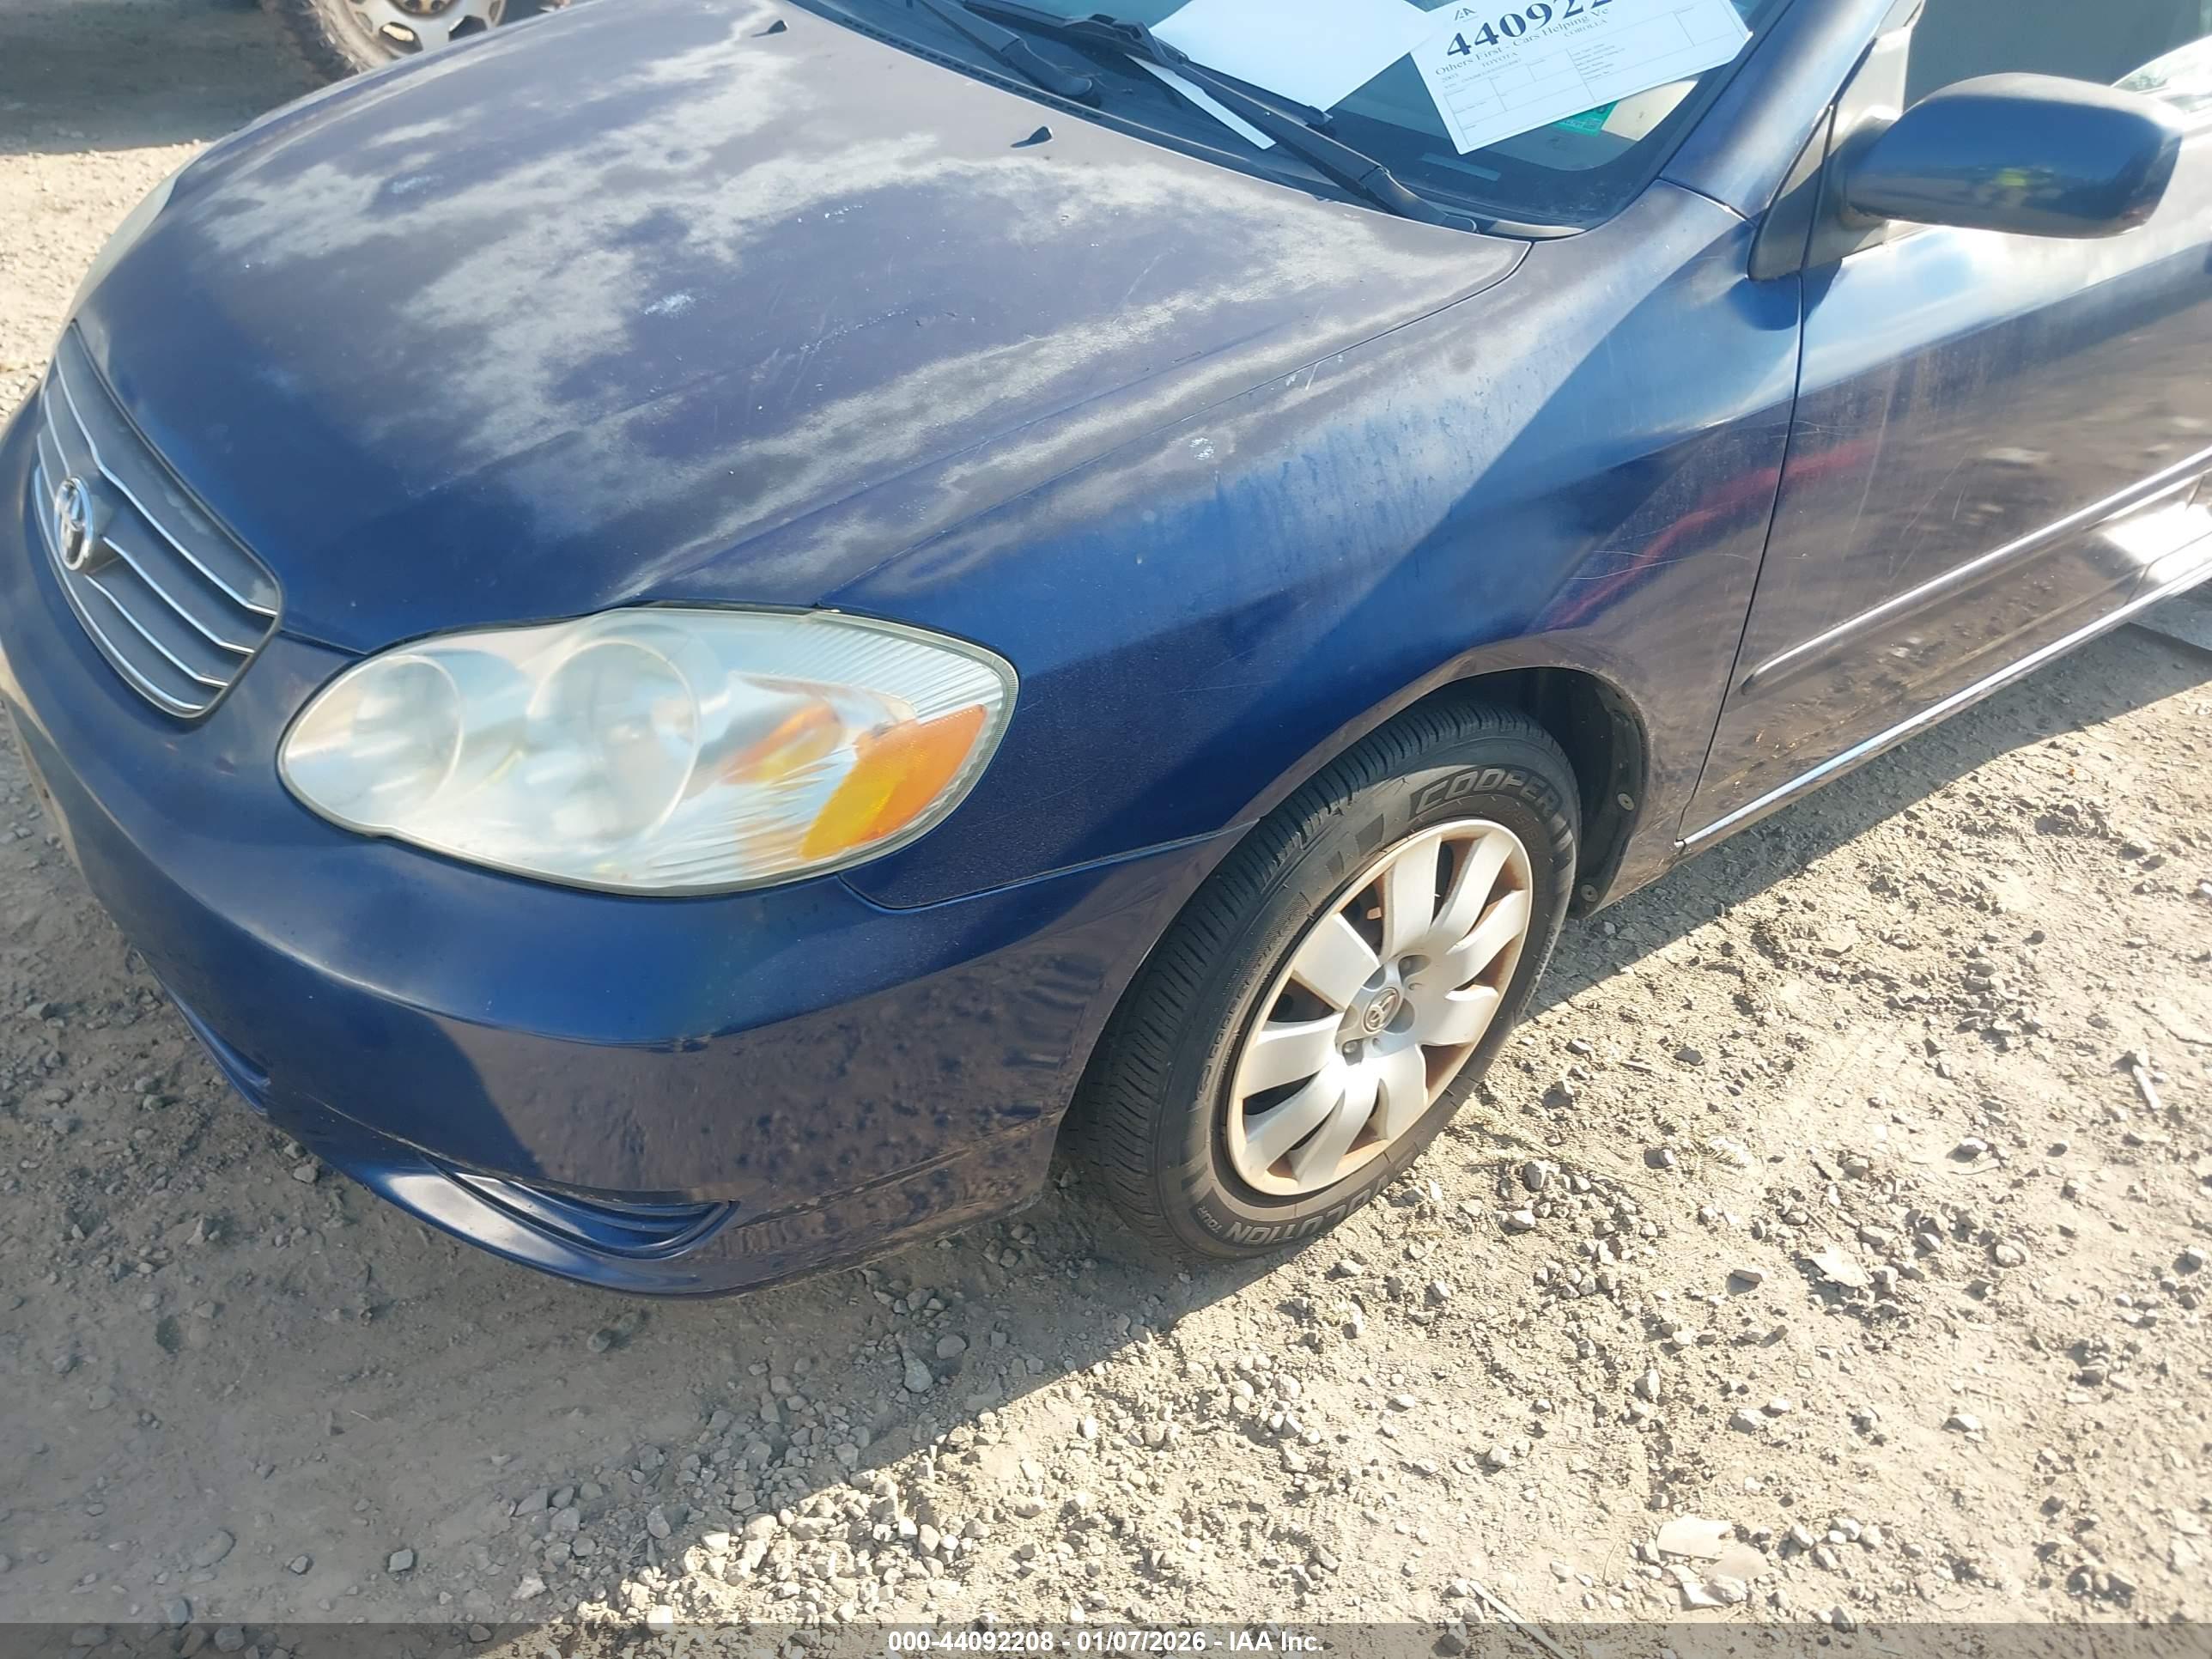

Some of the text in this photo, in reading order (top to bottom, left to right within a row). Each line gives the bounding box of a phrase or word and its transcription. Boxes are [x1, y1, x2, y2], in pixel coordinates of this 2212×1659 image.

[1436, 58, 1474, 76] Others
[1476, 47, 1503, 61] First
[1513, 33, 1540, 46] Cars
[1542, 15, 1589, 36] Helping
[1482, 52, 1519, 67] TOYOTA
[1564, 19, 1607, 37] COROLLA
[1416, 769, 1560, 817] COOPER
